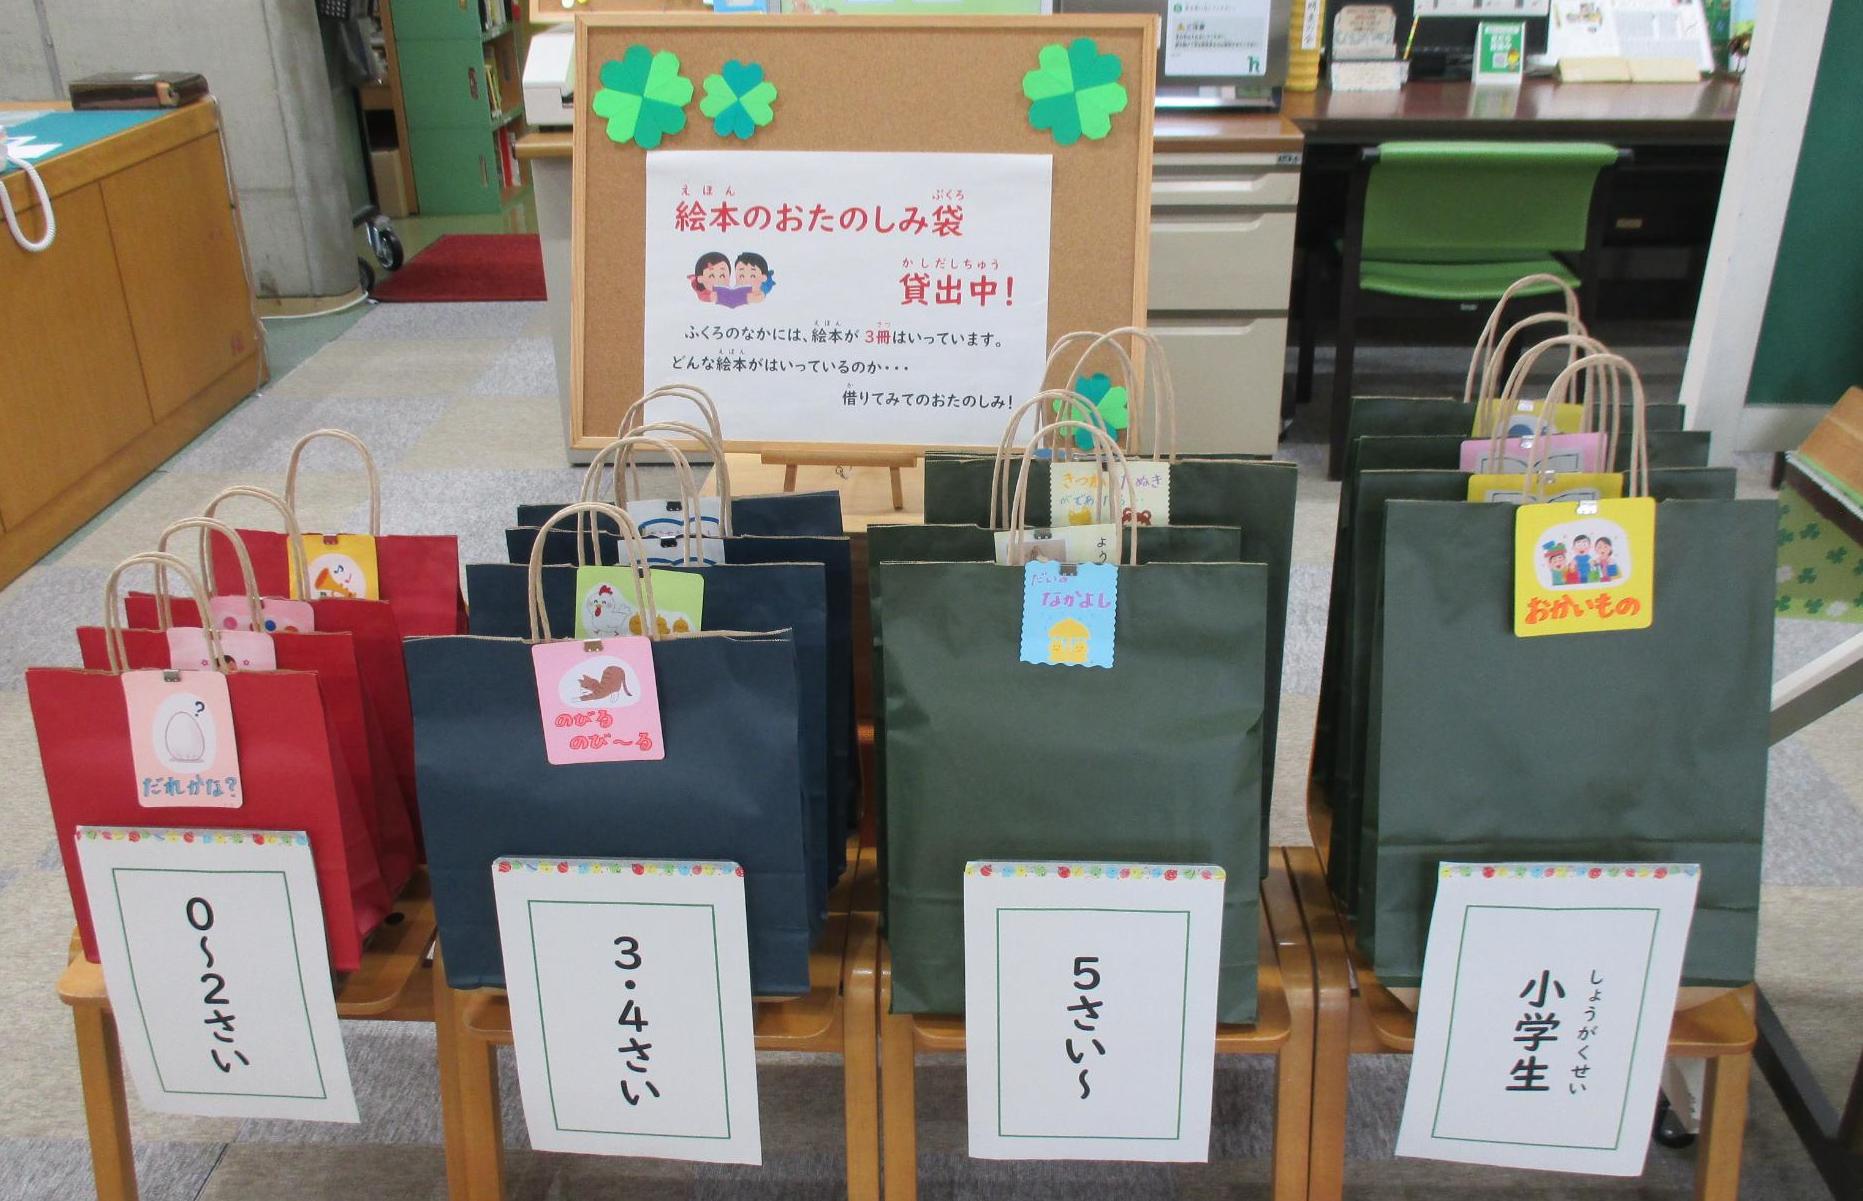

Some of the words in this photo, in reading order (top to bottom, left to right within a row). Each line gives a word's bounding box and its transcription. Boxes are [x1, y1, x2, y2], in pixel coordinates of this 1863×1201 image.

[681, 184, 737, 197] えほん
[931, 189, 965, 201] ぶくろ
[674, 200, 964, 237] 絵本のおたのしみ袋
[902, 256, 999, 271] かしだしちゅう
[898, 272, 1014, 307] 貸出中!
[842, 390, 1013, 410] 借りてみてのおたのしみ!
[1525, 593, 1641, 625] おかいもの
[554, 709, 614, 728] のびる
[1505, 969, 1566, 1091] 小学生
[1569, 969, 1604, 1095] しょうがくせい
